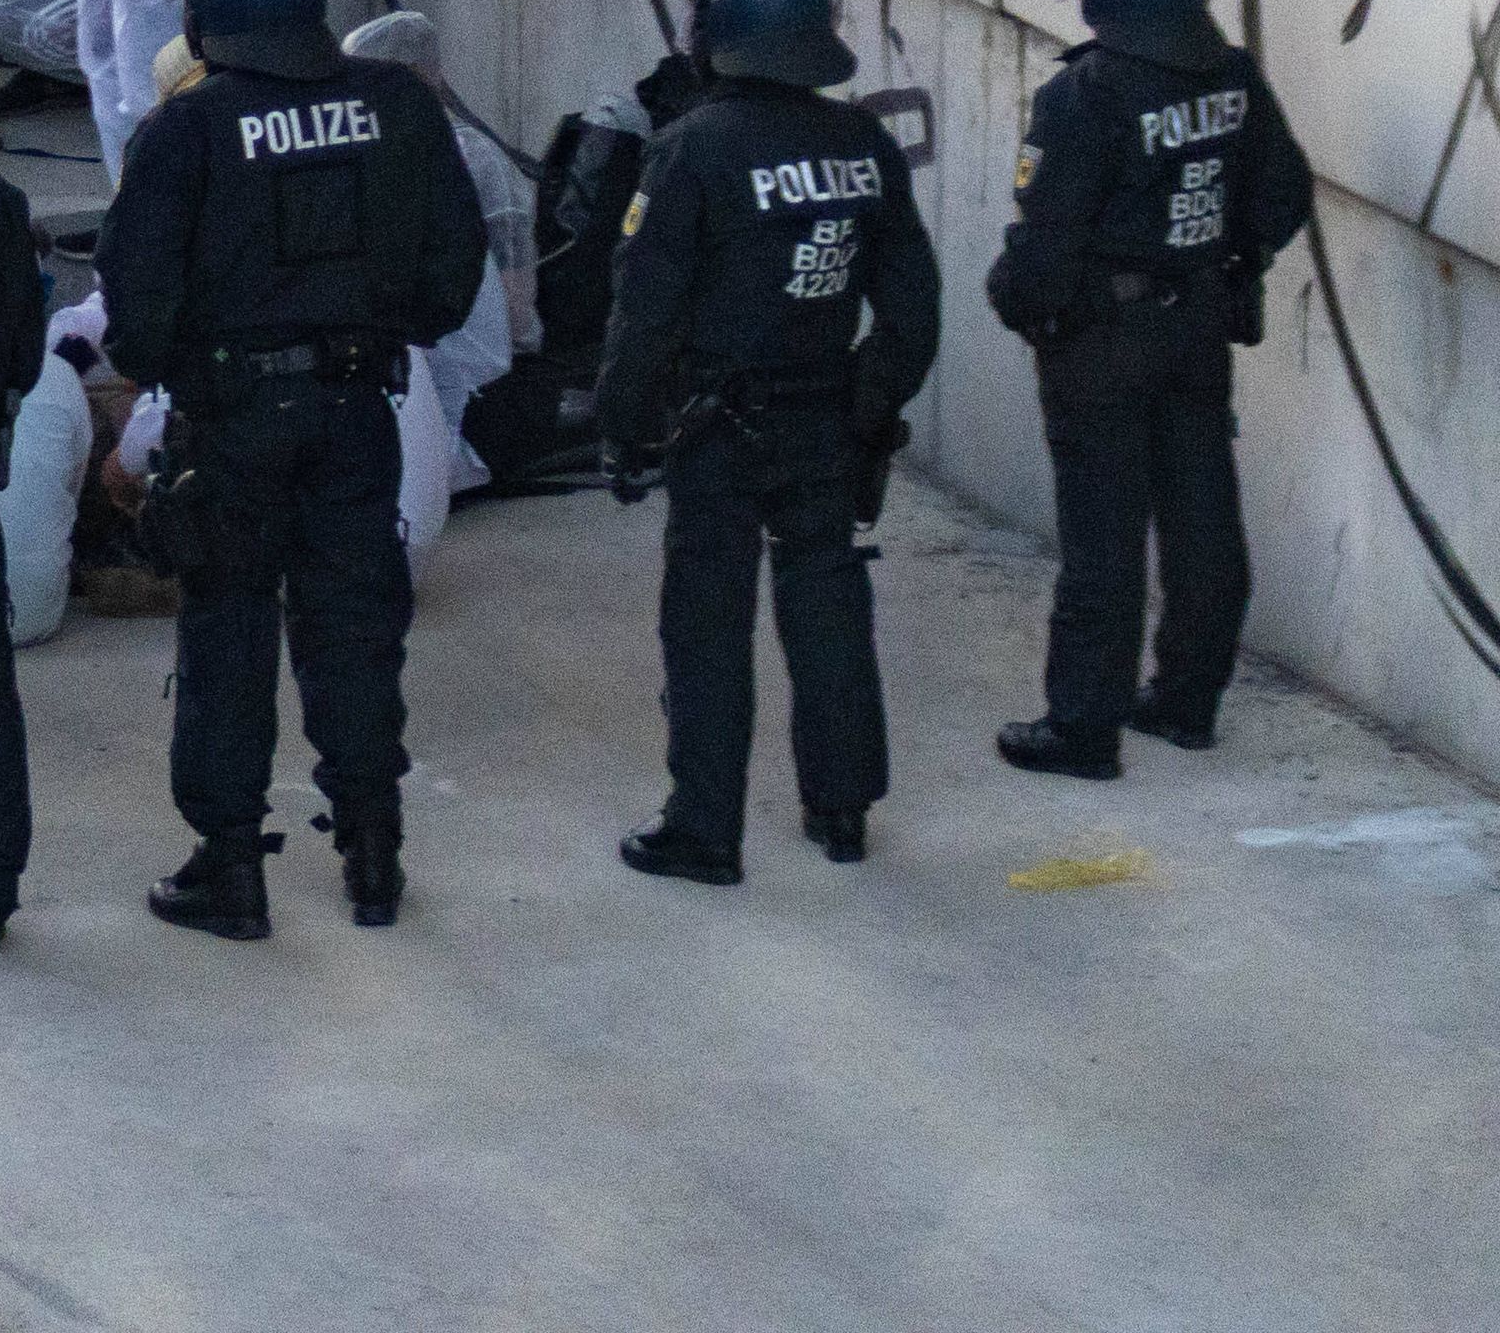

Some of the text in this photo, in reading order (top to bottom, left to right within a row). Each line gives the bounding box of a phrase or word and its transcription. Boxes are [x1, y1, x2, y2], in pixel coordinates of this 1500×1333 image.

[239, 99, 381, 159] POLIZEI
[1140, 89, 1248, 155] POLIZEI
[751, 157, 881, 210] POLIZEI
[1182, 158, 1223, 189] BP
